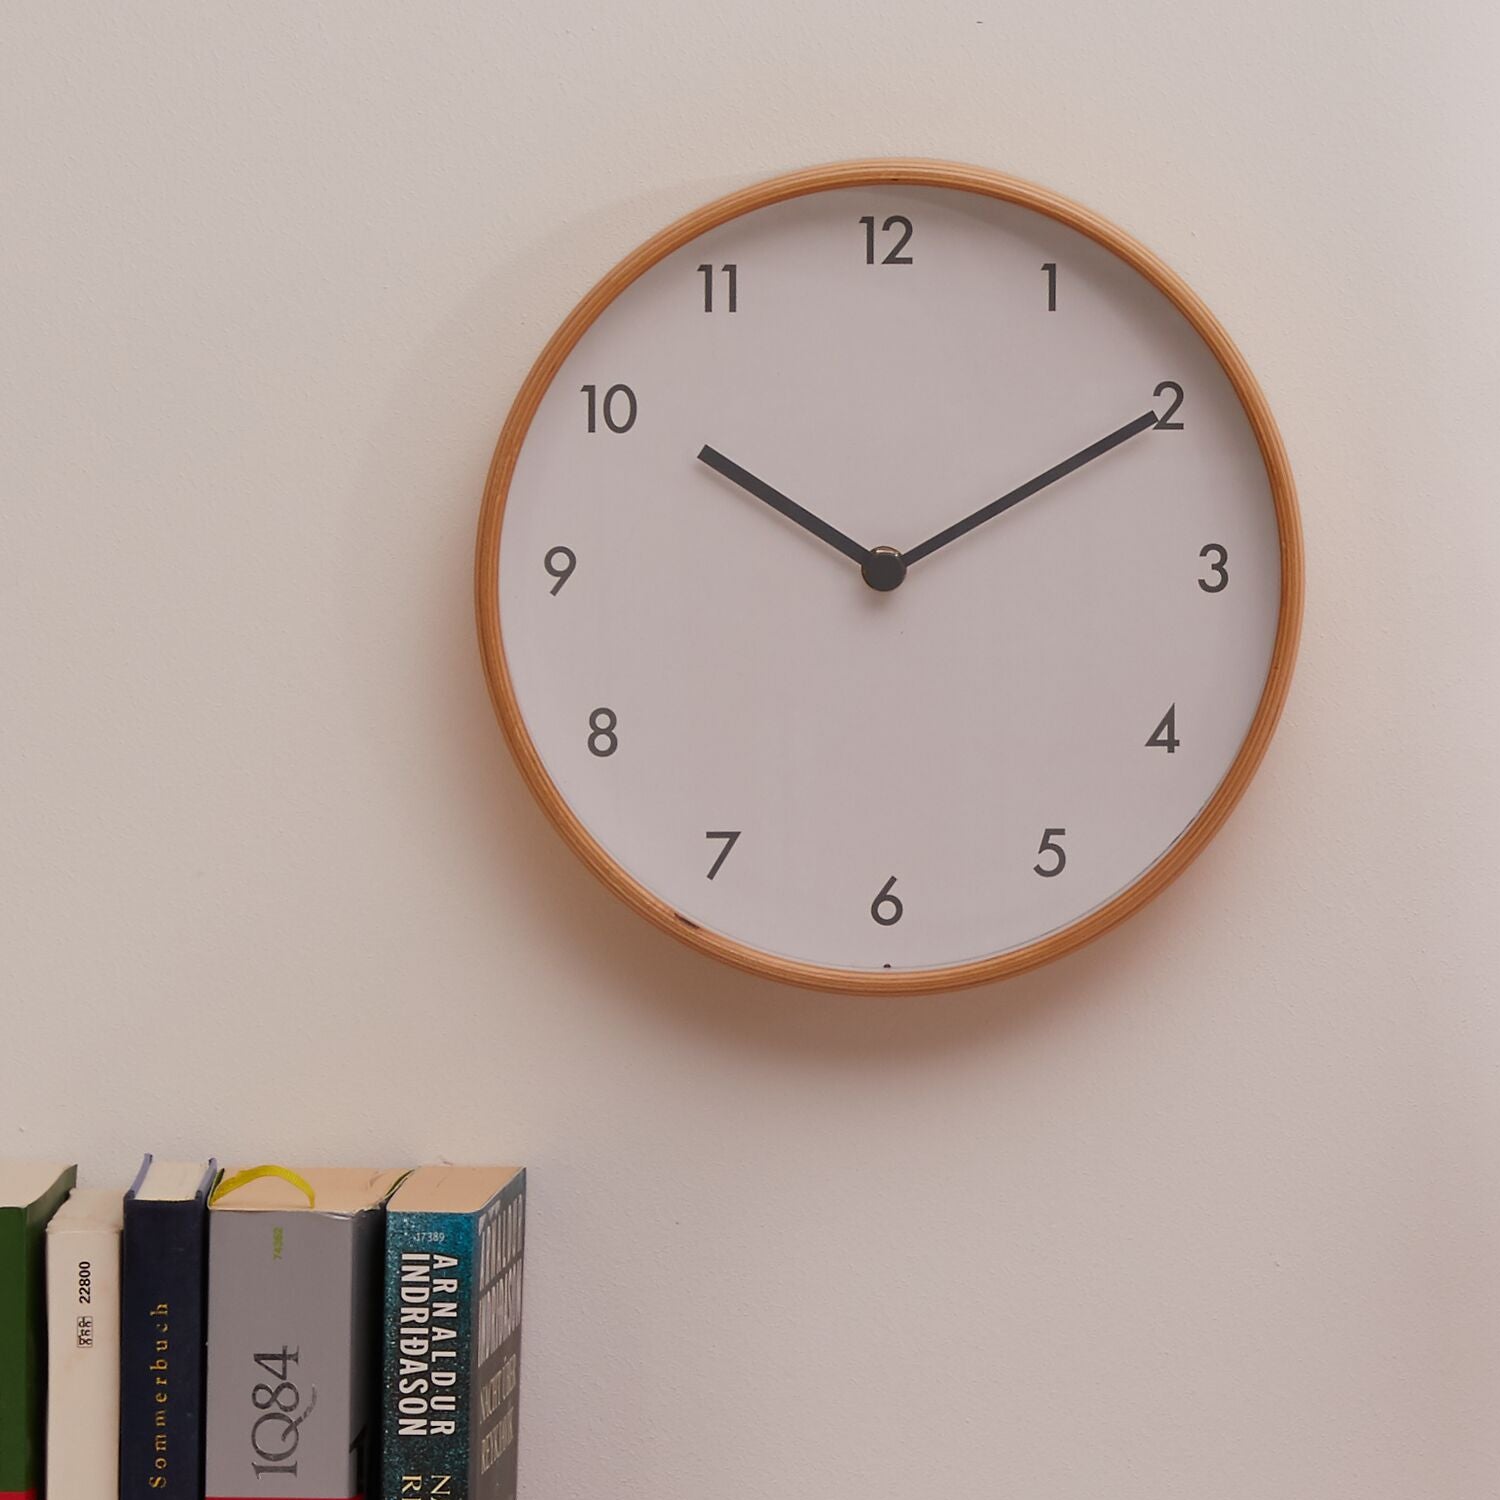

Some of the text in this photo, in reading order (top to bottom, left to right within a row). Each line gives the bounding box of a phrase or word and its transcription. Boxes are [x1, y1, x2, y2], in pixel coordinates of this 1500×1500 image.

[859, 215, 913, 264] 12
[697, 264, 737, 312] 11
[1041, 263, 1057, 312] 1
[580, 384, 638, 433] 10
[1152, 381, 1184, 430] 2
[544, 546, 577, 596] 9
[1198, 544, 1229, 593] 3
[587, 708, 618, 757] 8
[1145, 703, 1181, 753] 4
[706, 832, 741, 880] 7
[1034, 829, 1067, 877] 5
[871, 876, 903, 926] 6
[78, 1261, 91, 1304] 22800
[430, 1254, 458, 1435] ARNALDUR
[150, 1303, 168, 1489] Sommerbuch
[251, 1345, 316, 1480] 1Q84
